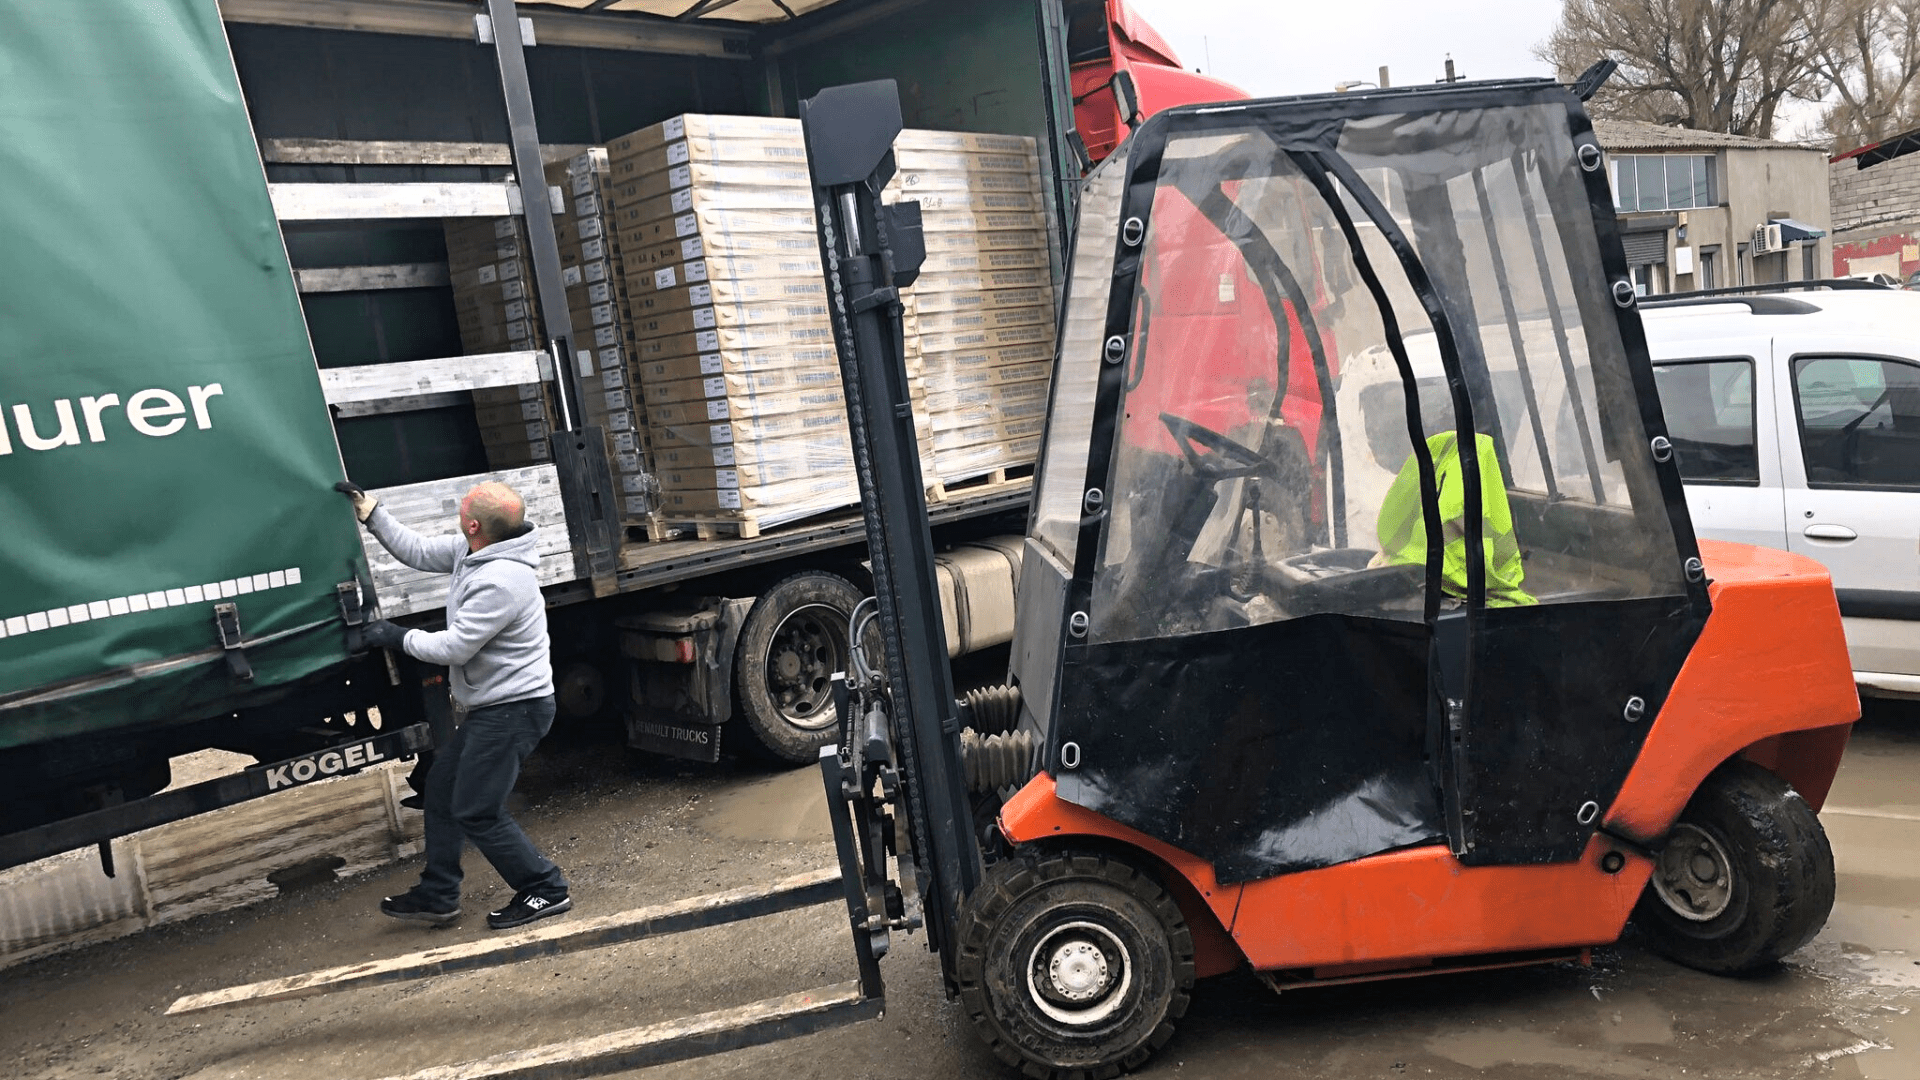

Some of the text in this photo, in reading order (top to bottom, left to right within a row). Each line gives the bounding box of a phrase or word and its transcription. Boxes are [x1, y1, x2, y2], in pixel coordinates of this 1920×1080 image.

[635, 720, 709, 745] RENAULT TRUCKS
[266, 741, 385, 791] KÖGEL
